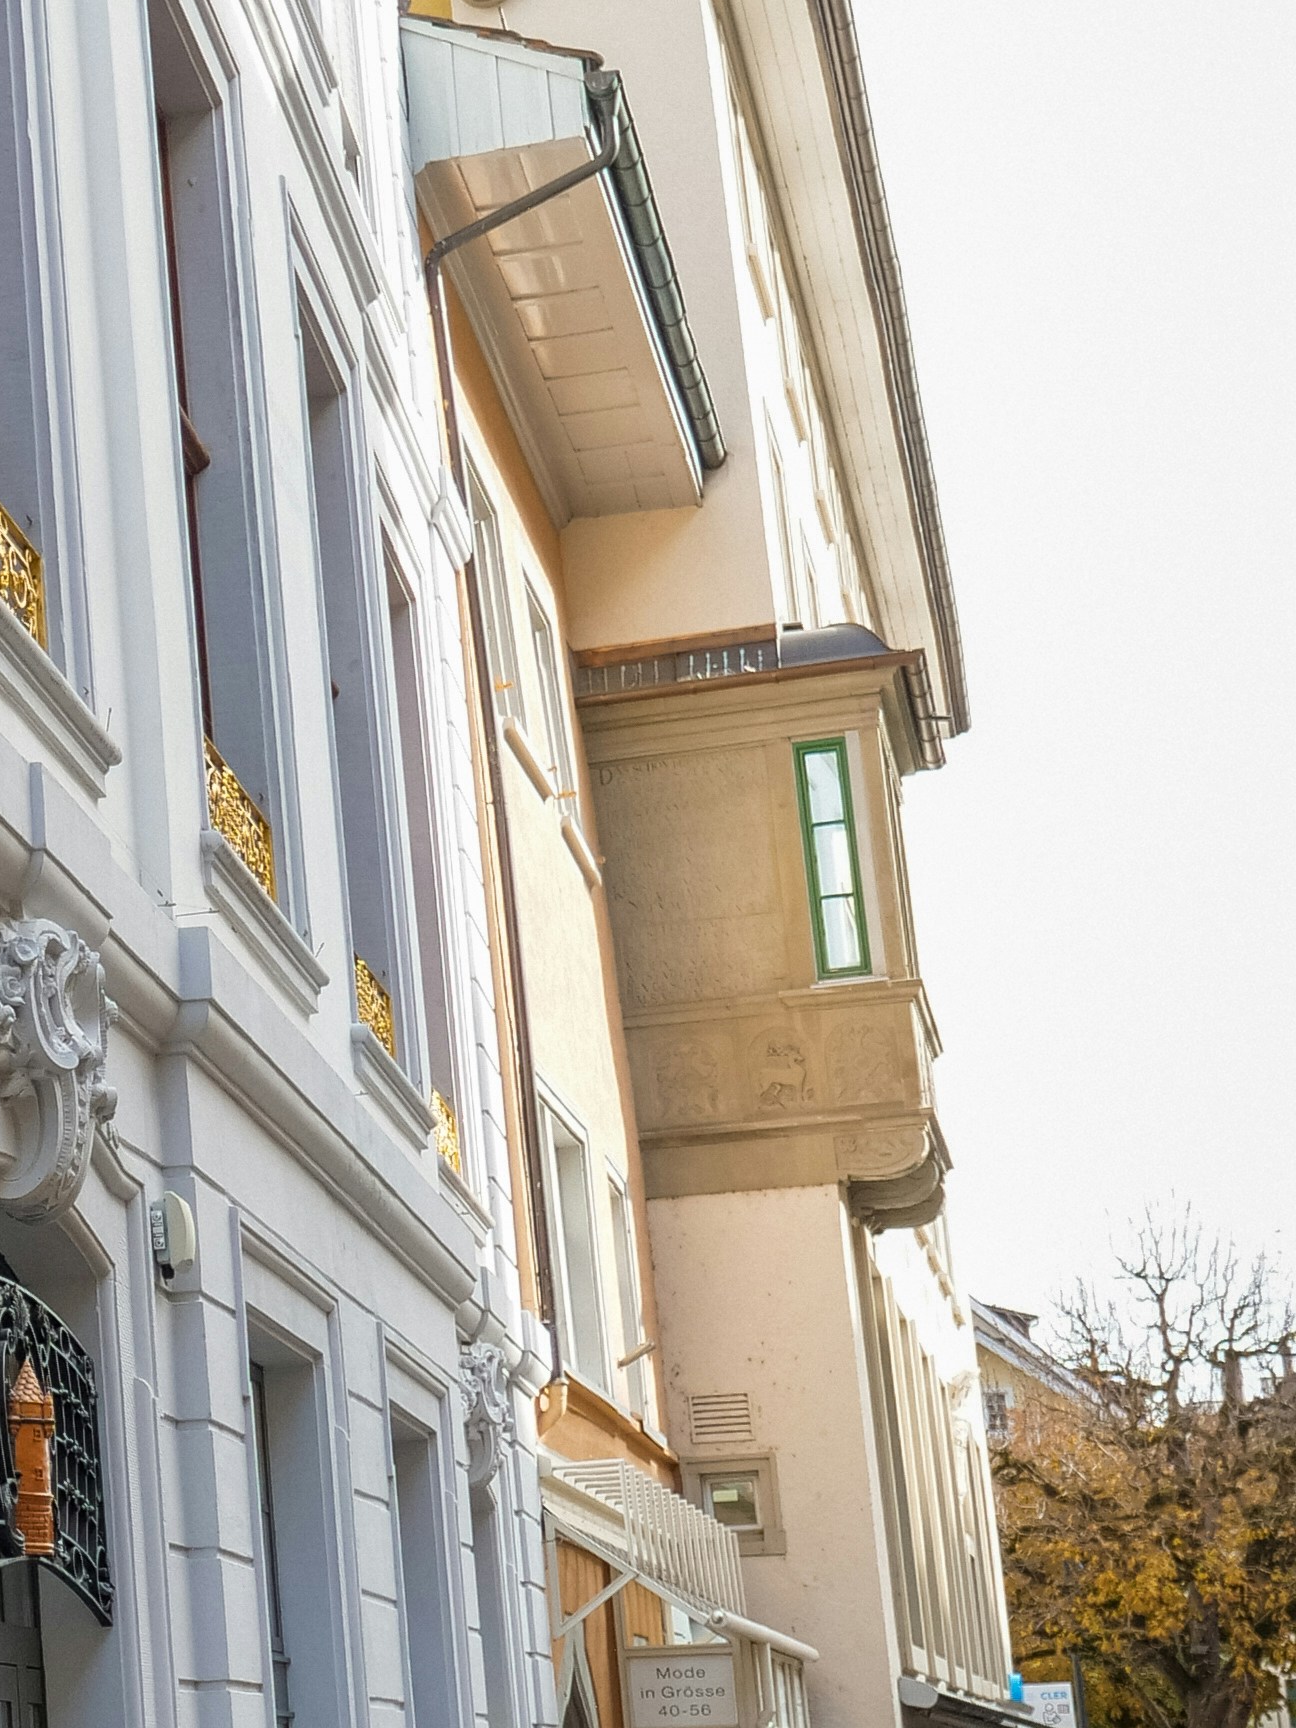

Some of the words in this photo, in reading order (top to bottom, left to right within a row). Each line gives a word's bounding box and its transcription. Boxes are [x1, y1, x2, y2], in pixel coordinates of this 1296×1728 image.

[655, 1666, 706, 1679] Mode
[640, 1686, 655, 1699] in
[661, 1685, 726, 1699] Grösse
[1040, 1691, 1068, 1701] CLER
[658, 1703, 712, 1717] 40-56
